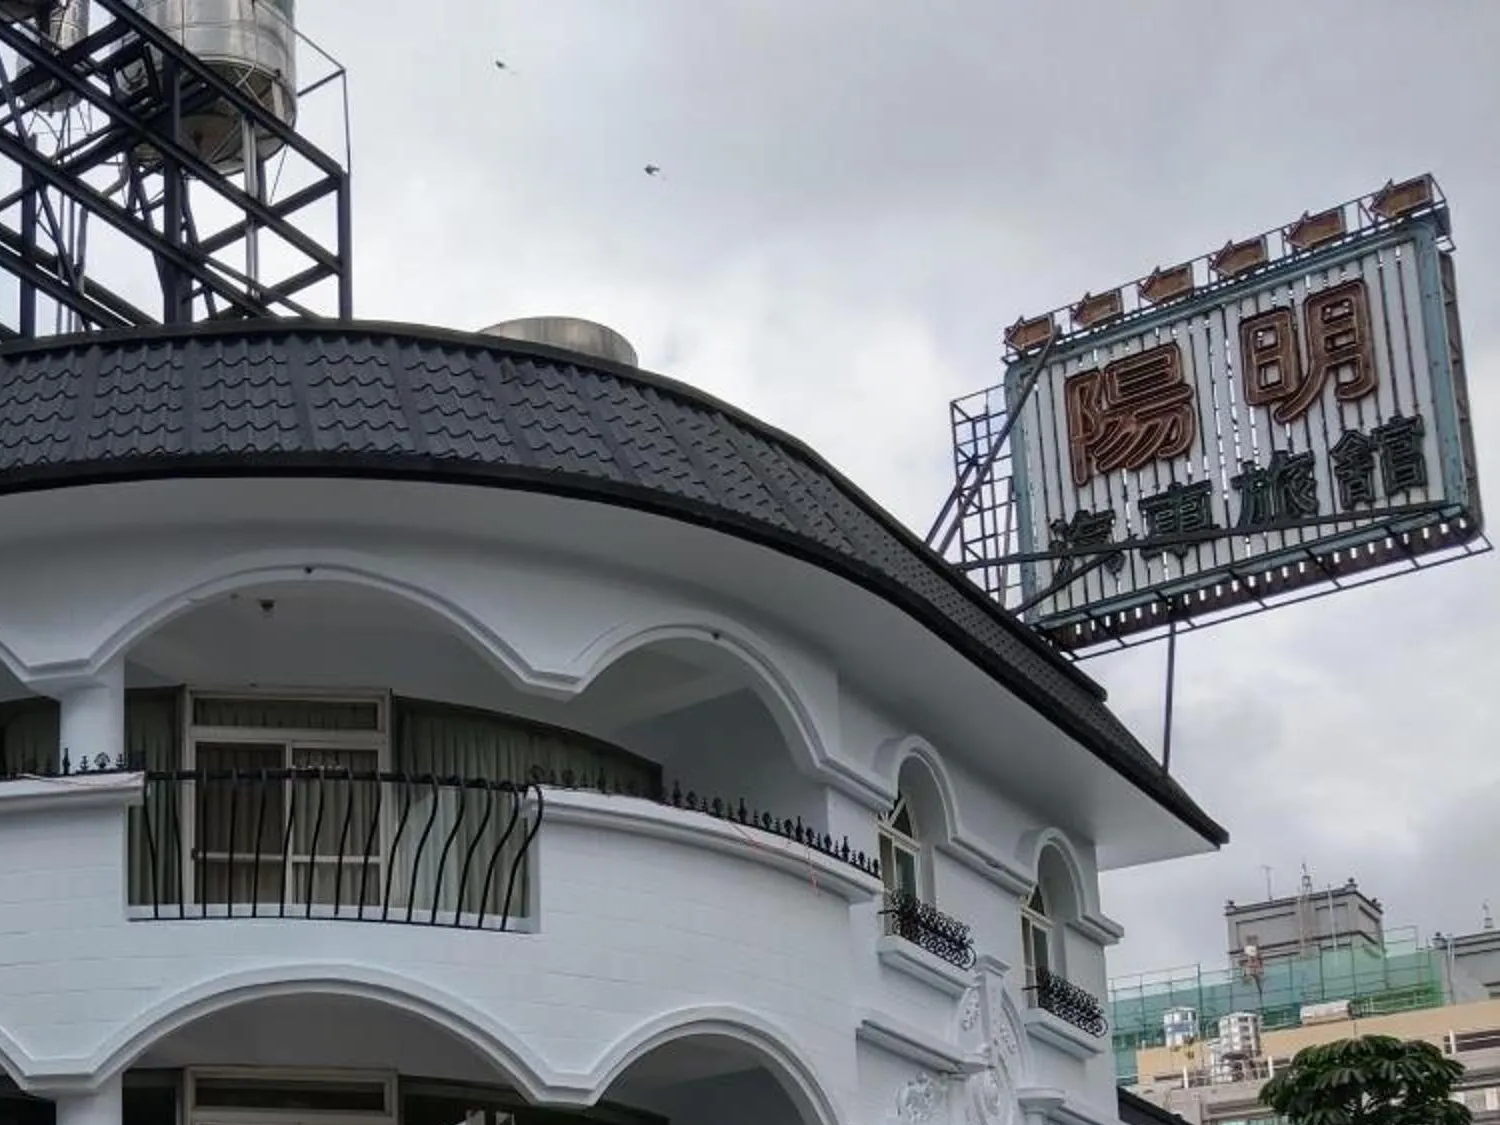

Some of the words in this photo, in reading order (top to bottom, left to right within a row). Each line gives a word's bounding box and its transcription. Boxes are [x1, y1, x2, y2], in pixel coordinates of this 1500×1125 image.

[1064, 278, 1379, 487] 陽明
[1048, 414, 1428, 578] 汽車旅館
